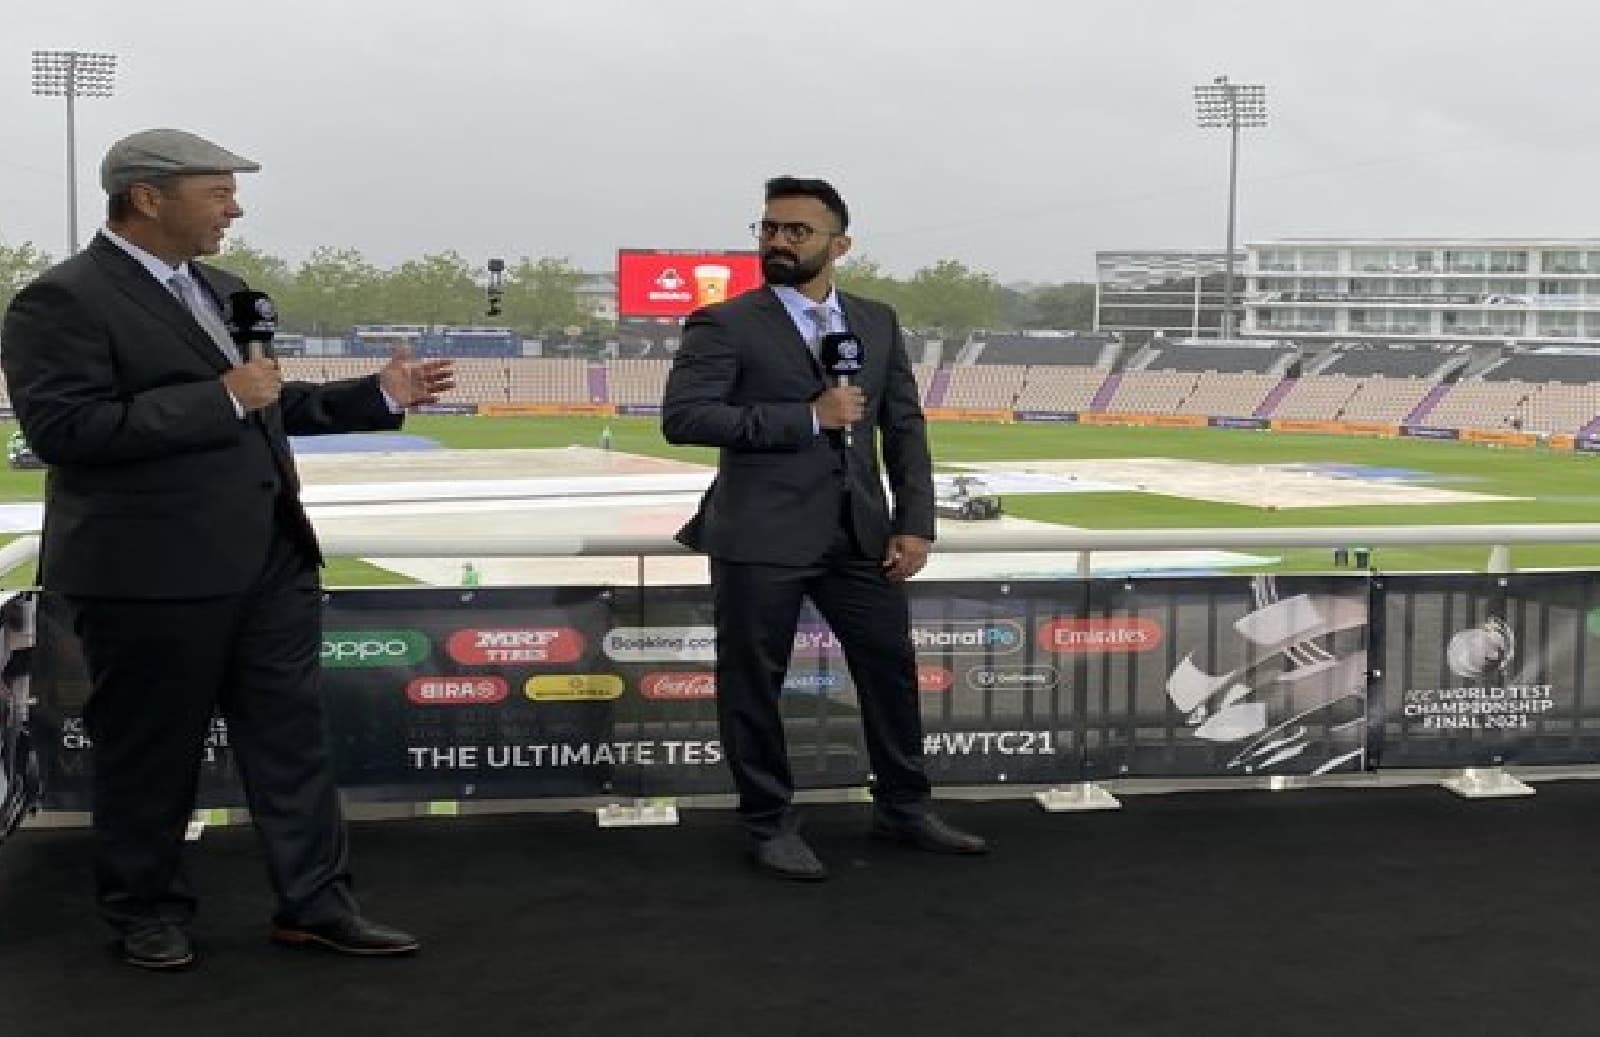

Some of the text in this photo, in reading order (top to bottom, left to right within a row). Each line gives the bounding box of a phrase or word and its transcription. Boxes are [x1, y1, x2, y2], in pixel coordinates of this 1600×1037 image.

[475, 631, 558, 648] MRF
[1054, 628, 1149, 645] Emirates
[1439, 687, 1504, 700] WORLD
[1507, 685, 1552, 699] TEST
[1405, 699, 1552, 716] CHAMPIONSHIP
[1424, 715, 1480, 728] FINAL
[922, 730, 1056, 755] #WTC21
[407, 740, 721, 769] THE ULTIMATE TES
